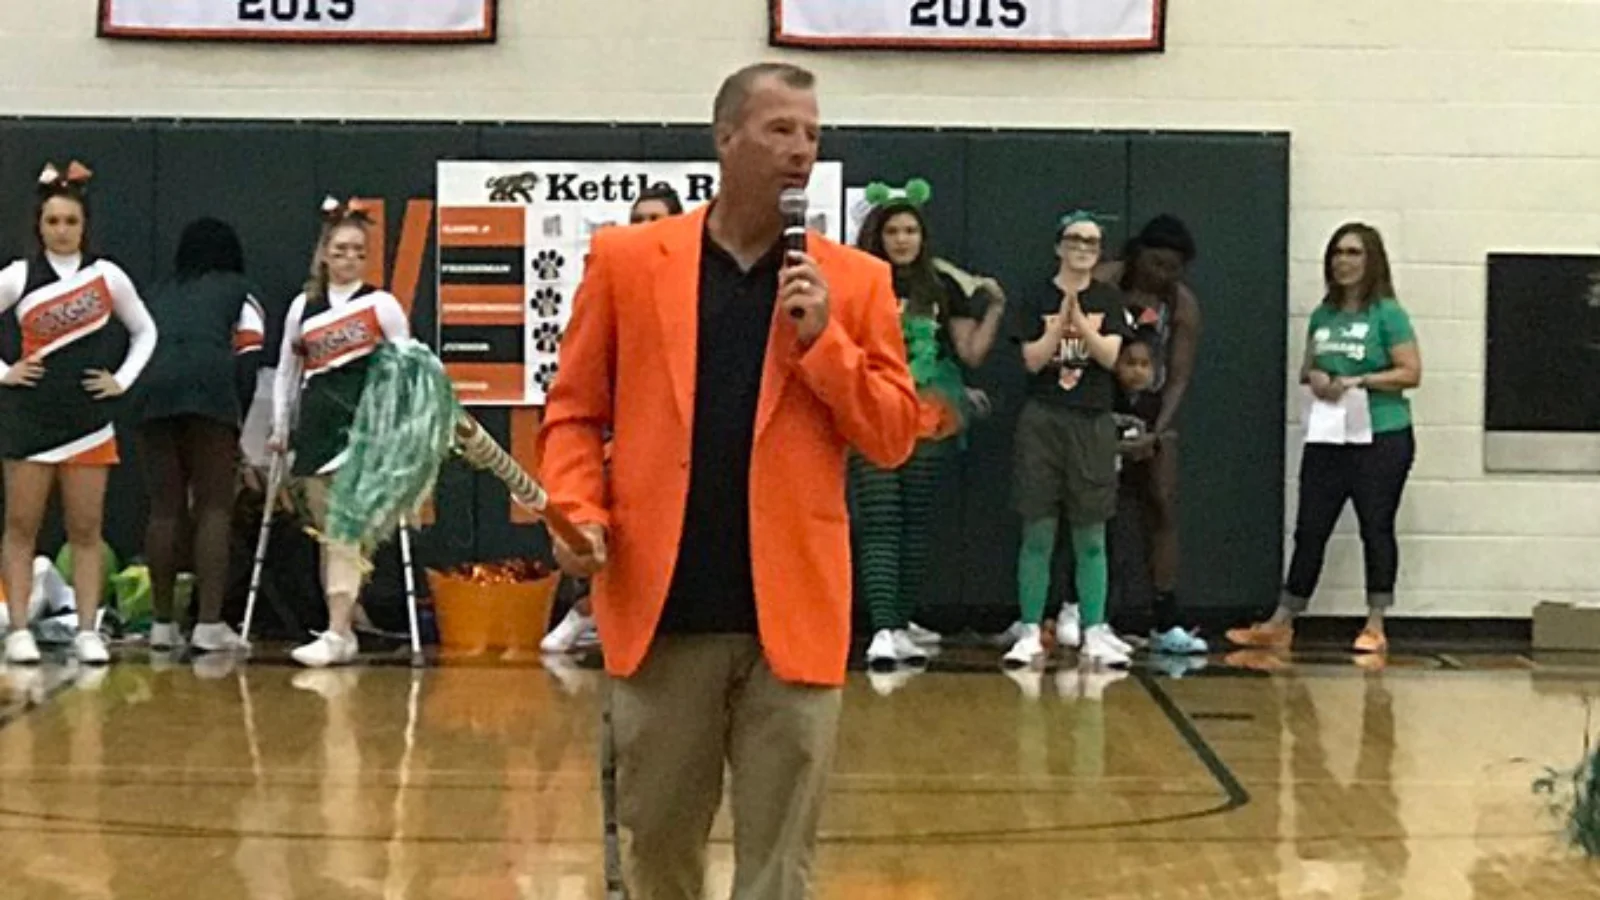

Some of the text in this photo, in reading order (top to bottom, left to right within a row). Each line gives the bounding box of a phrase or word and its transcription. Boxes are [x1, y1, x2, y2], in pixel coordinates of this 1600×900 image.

[238, 0, 355, 21] 2015
[910, 0, 1027, 28] 2015
[686, 173, 714, 201] R
